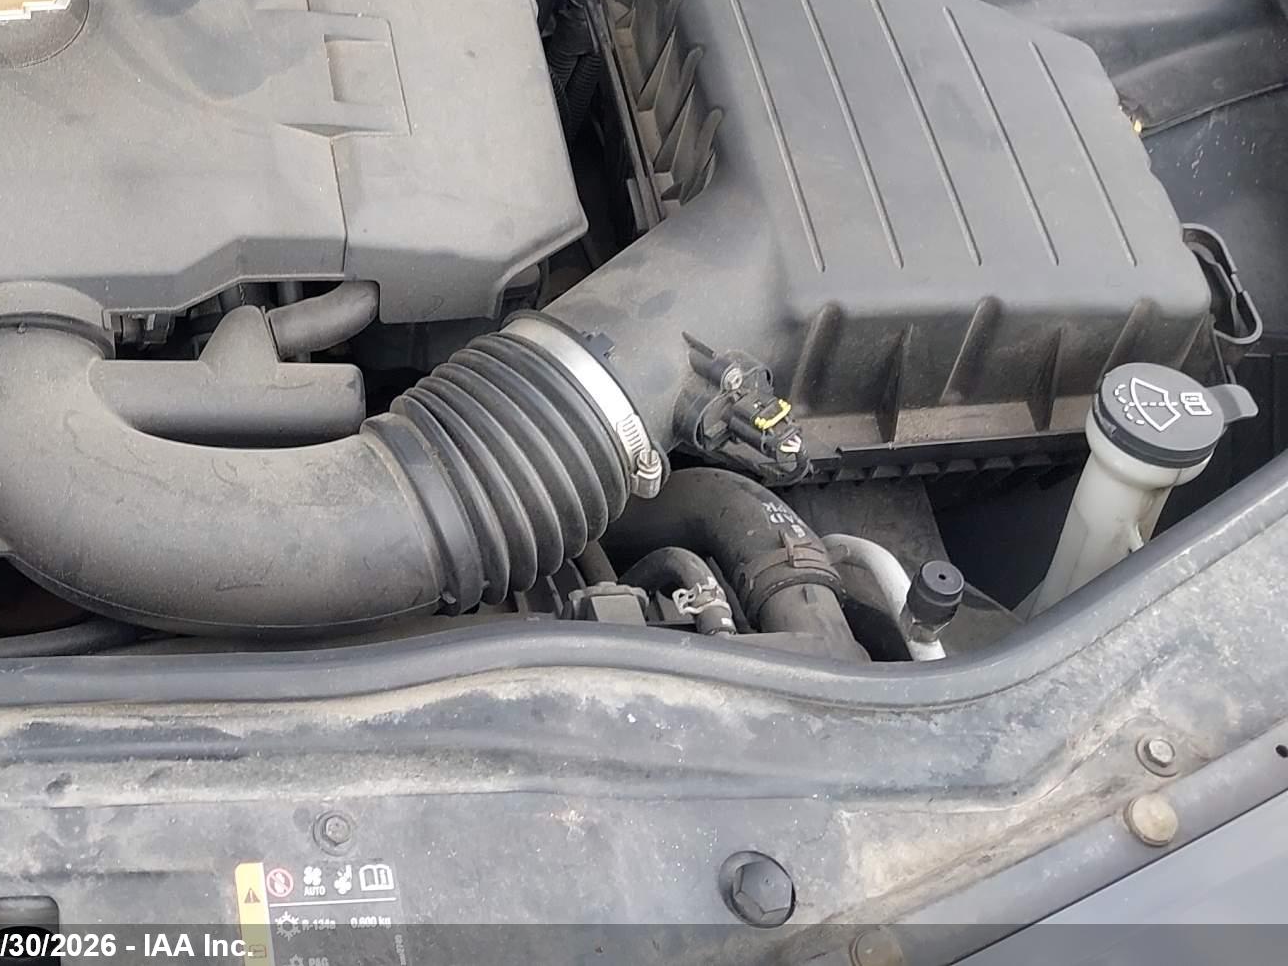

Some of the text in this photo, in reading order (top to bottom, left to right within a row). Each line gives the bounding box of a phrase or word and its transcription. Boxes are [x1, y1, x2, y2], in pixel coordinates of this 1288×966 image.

[303, 885, 326, 896] AUTO
[301, 918, 336, 931] R-134a
[378, 915, 392, 930] kg
